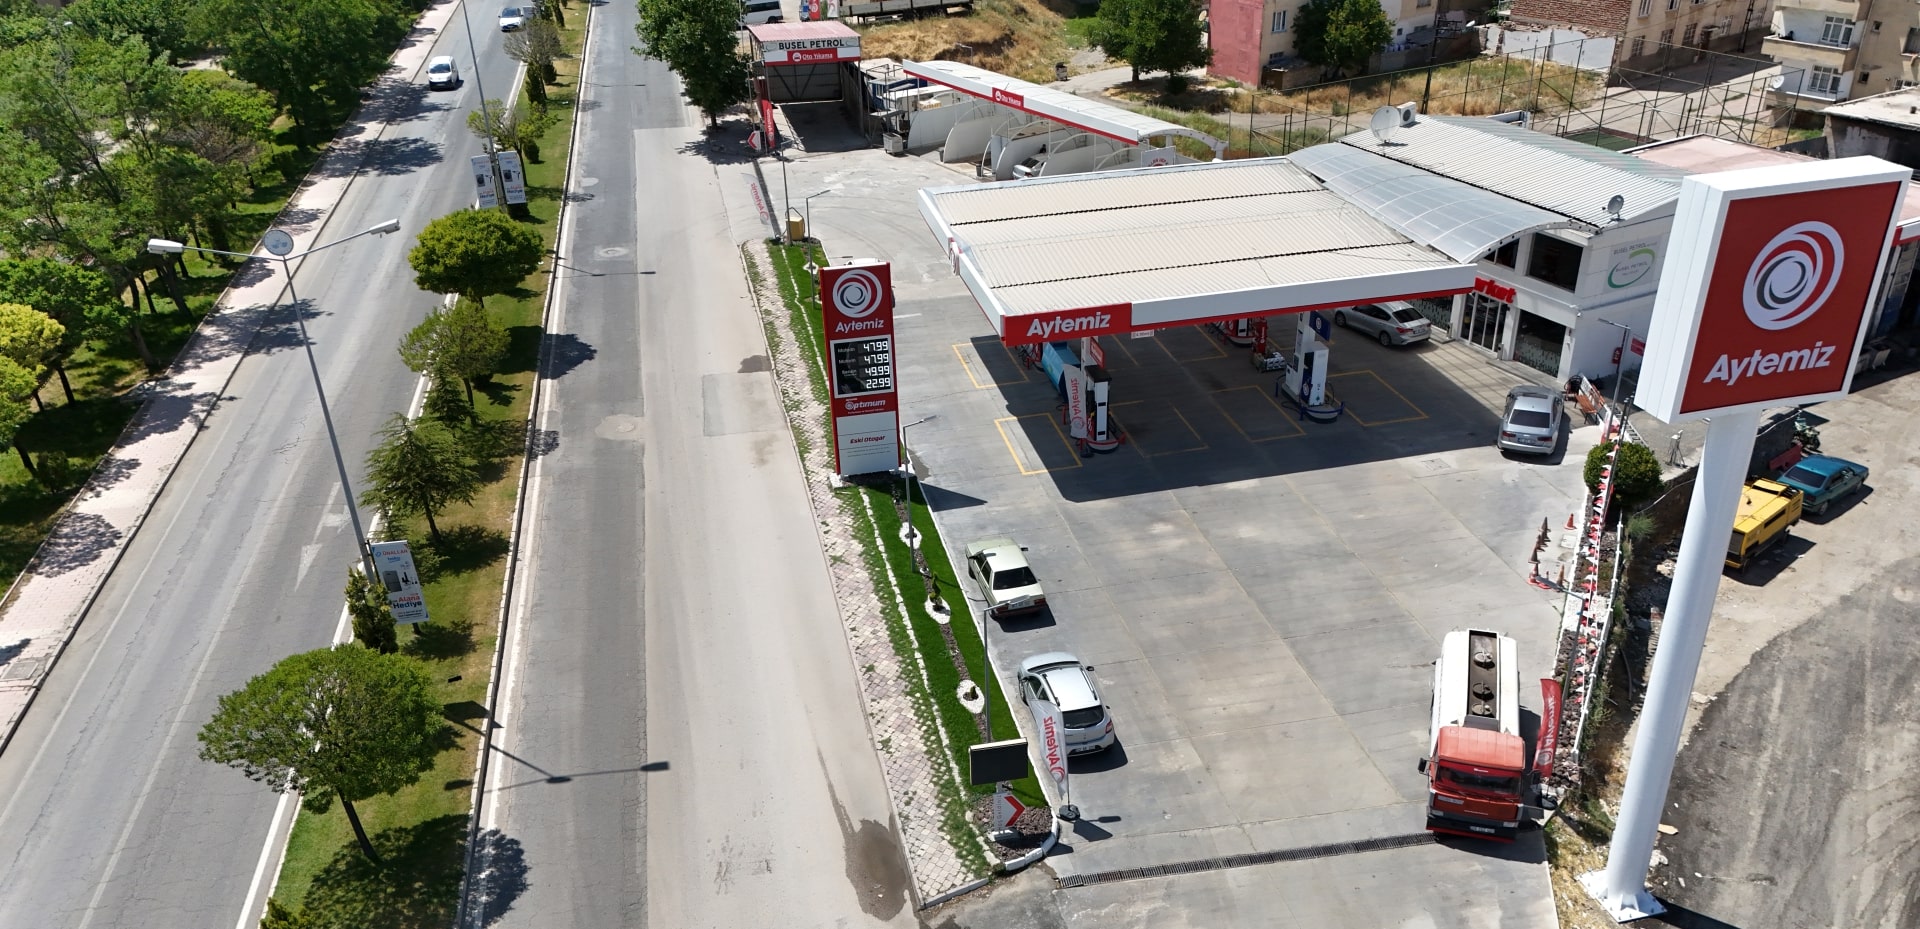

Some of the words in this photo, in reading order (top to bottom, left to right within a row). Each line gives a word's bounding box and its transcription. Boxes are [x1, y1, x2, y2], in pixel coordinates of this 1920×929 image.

[779, 41, 807, 50] BUSEL
[810, 39, 844, 48] PETROL
[835, 318, 884, 333] Aytemiz
[1026, 312, 1111, 338] Aytemiz
[863, 341, 889, 352] 47.99
[864, 353, 889, 364] 47.99
[1703, 341, 1836, 386] Aytemiz
[865, 365, 890, 376] 49.99
[866, 377, 891, 389] 22.99
[864, 435, 886, 443] Otogar
[398, 594, 420, 603] Alana
[392, 600, 422, 609] Hediye
